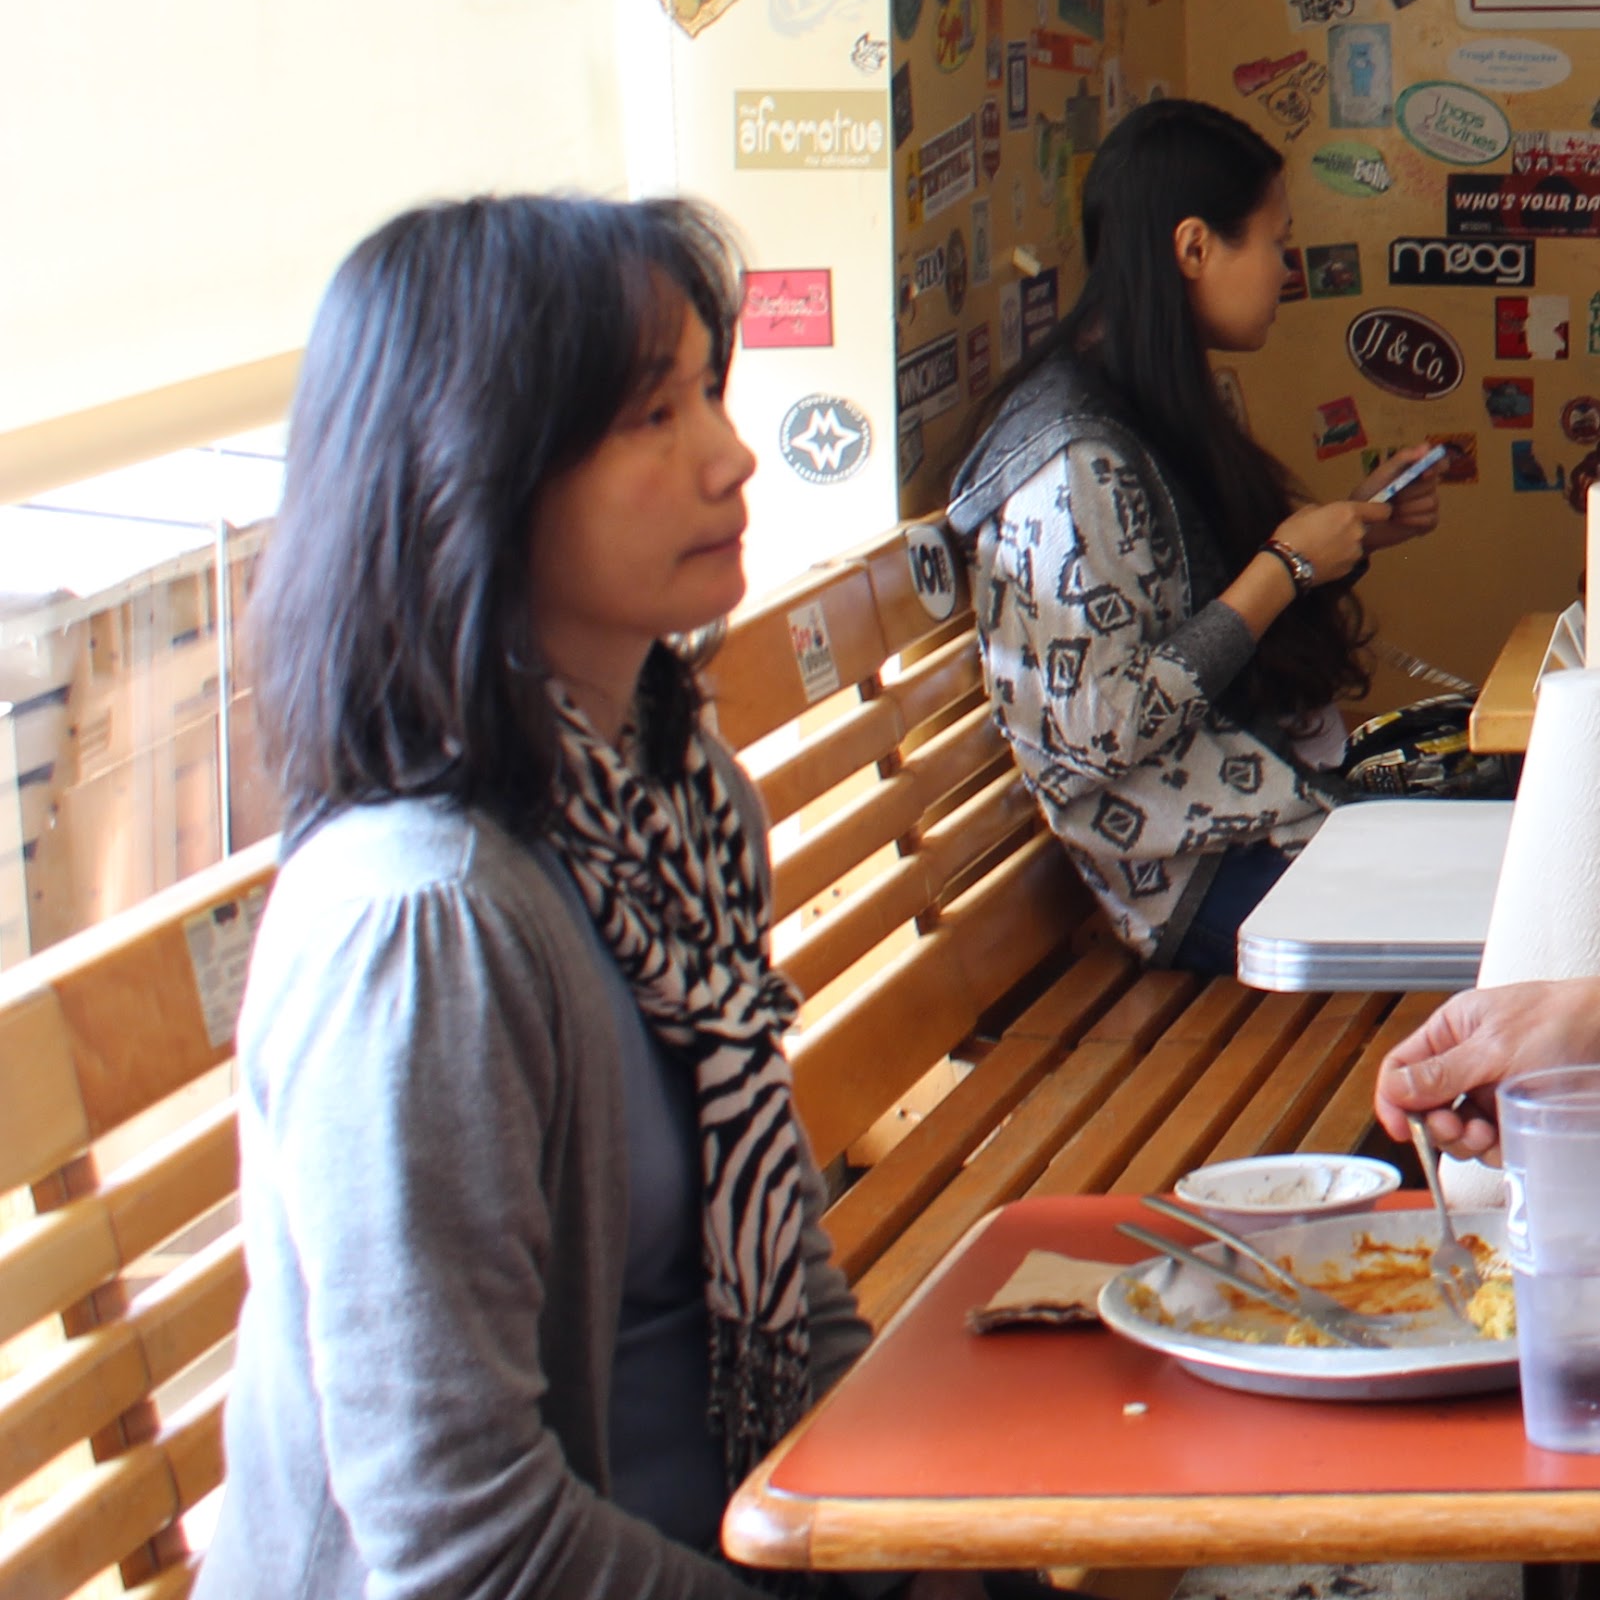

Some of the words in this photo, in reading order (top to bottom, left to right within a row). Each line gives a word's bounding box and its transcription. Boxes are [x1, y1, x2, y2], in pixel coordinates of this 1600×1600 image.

[1441, 100, 1487, 130] hops
[1450, 121, 1497, 152] vines
[1454, 193, 1515, 211] WHO'S
[1519, 193, 1570, 212] YOUR
[1393, 241, 1527, 284] moog
[1362, 317, 1391, 359] JJ
[1388, 330, 1409, 366] &
[1412, 342, 1448, 384] Co.
